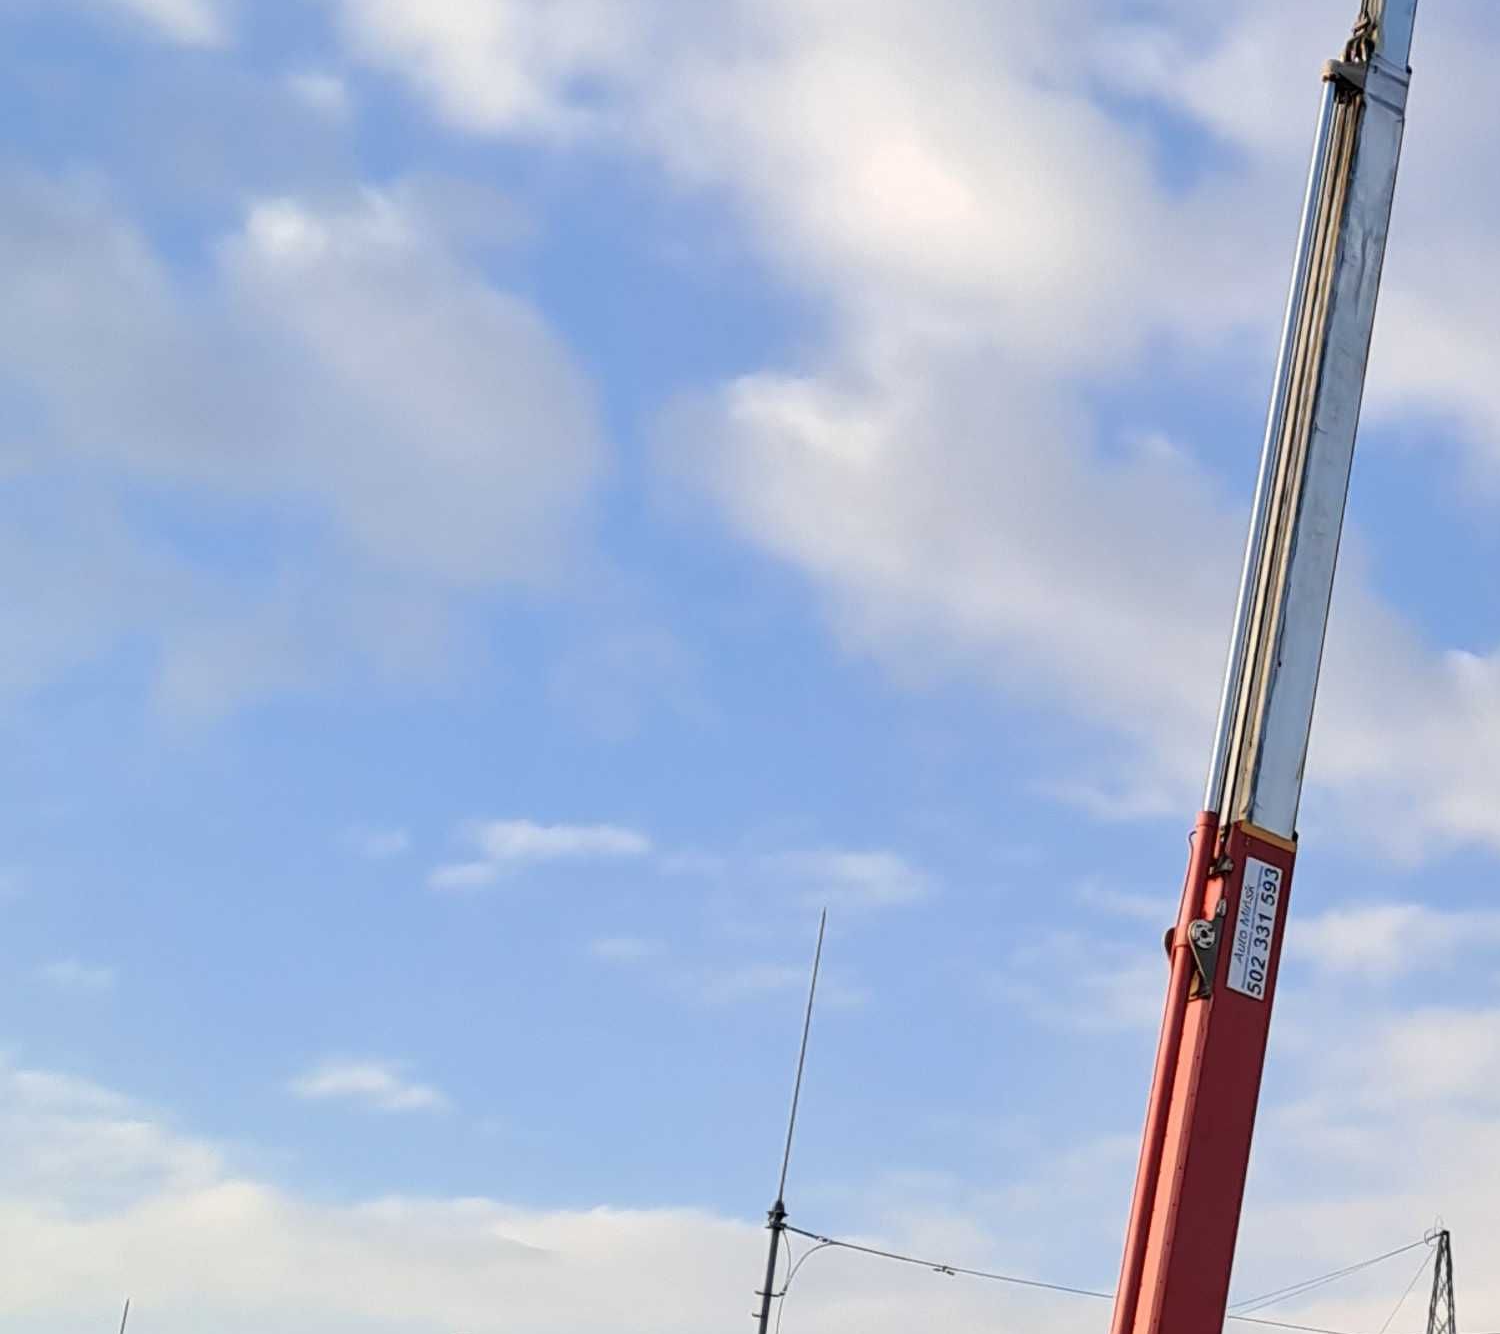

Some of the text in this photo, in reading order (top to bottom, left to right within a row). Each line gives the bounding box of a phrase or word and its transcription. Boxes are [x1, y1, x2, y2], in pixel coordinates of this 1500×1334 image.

[1233, 926, 1247, 963] Auto
[1247, 867, 1279, 996] 502 331 593
